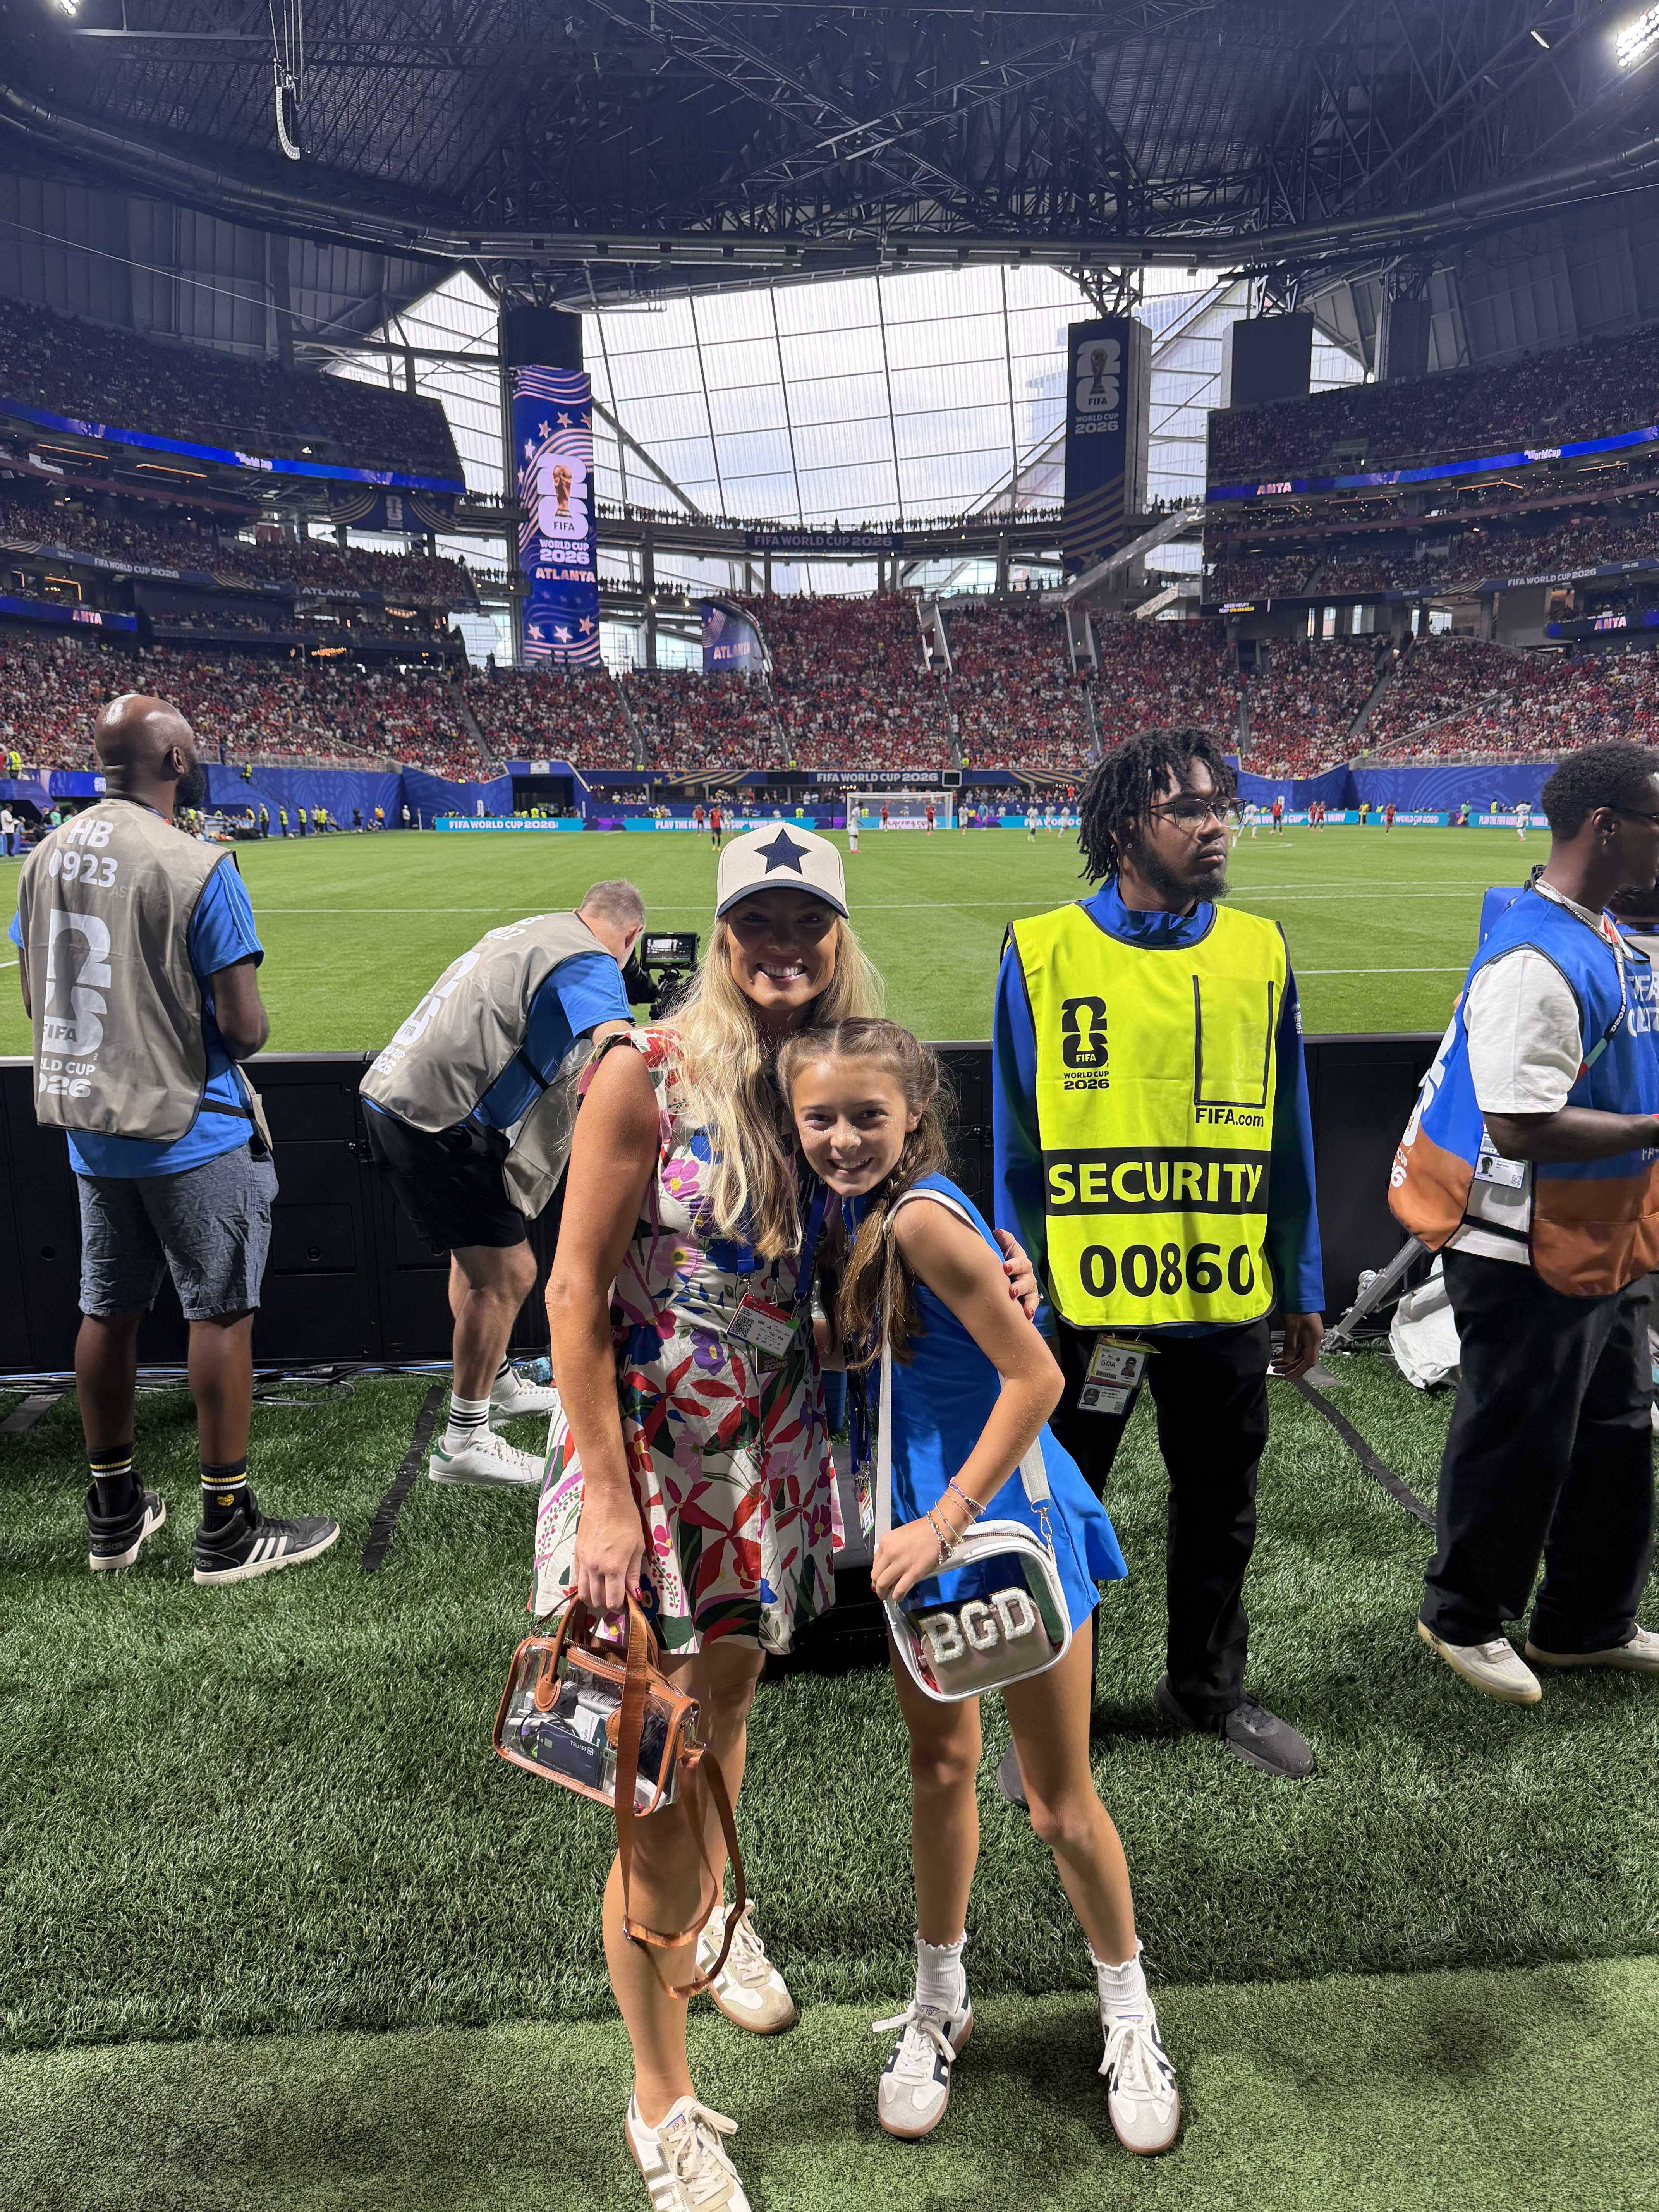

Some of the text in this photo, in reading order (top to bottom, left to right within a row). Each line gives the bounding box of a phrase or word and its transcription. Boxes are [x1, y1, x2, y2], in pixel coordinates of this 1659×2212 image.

[1088, 397, 1108, 405] FIFA
[1076, 414, 1103, 423] WORLD
[1075, 421, 1119, 434] 2026
[1257, 482, 1292, 495] ANTA
[554, 522, 575, 531] FIFA
[539, 539, 589, 551] WORLD CUP
[754, 536, 893, 546] FIFA WORLD CUP 2026
[540, 548, 590, 565] 2026
[94, 558, 180, 579] FIFA WORLD CUP 2026
[535, 567, 596, 583] ATLANTA
[1508, 568, 1597, 586] FIFA WORLD CUP 2026
[302, 587, 360, 598] ATLANTA
[73, 610, 102, 625] ANTA
[1594, 616, 1627, 630] ANTA
[817, 773, 938, 782] FIFA WORLD CUP 2026
[449, 820, 470, 829] FIFA
[470, 820, 503, 829] WORLD
[505, 820, 523, 829] CUP
[655, 820, 673, 829] PLAY
[67, 818, 113, 848] HB
[1076, 1053, 1097, 1062] FIFA
[65, 1061, 96, 1076] CUP
[1064, 1079, 1110, 1090] 2026
[1195, 1108, 1264, 1127] FIFA.com
[1048, 1161, 1263, 1204] SECURITY
[1080, 1243, 1255, 1297] 00860
[763, 1360, 788, 1371] 2026
[918, 1587, 1036, 1664] BGD
[570, 1740, 587, 1752] TRUIST
